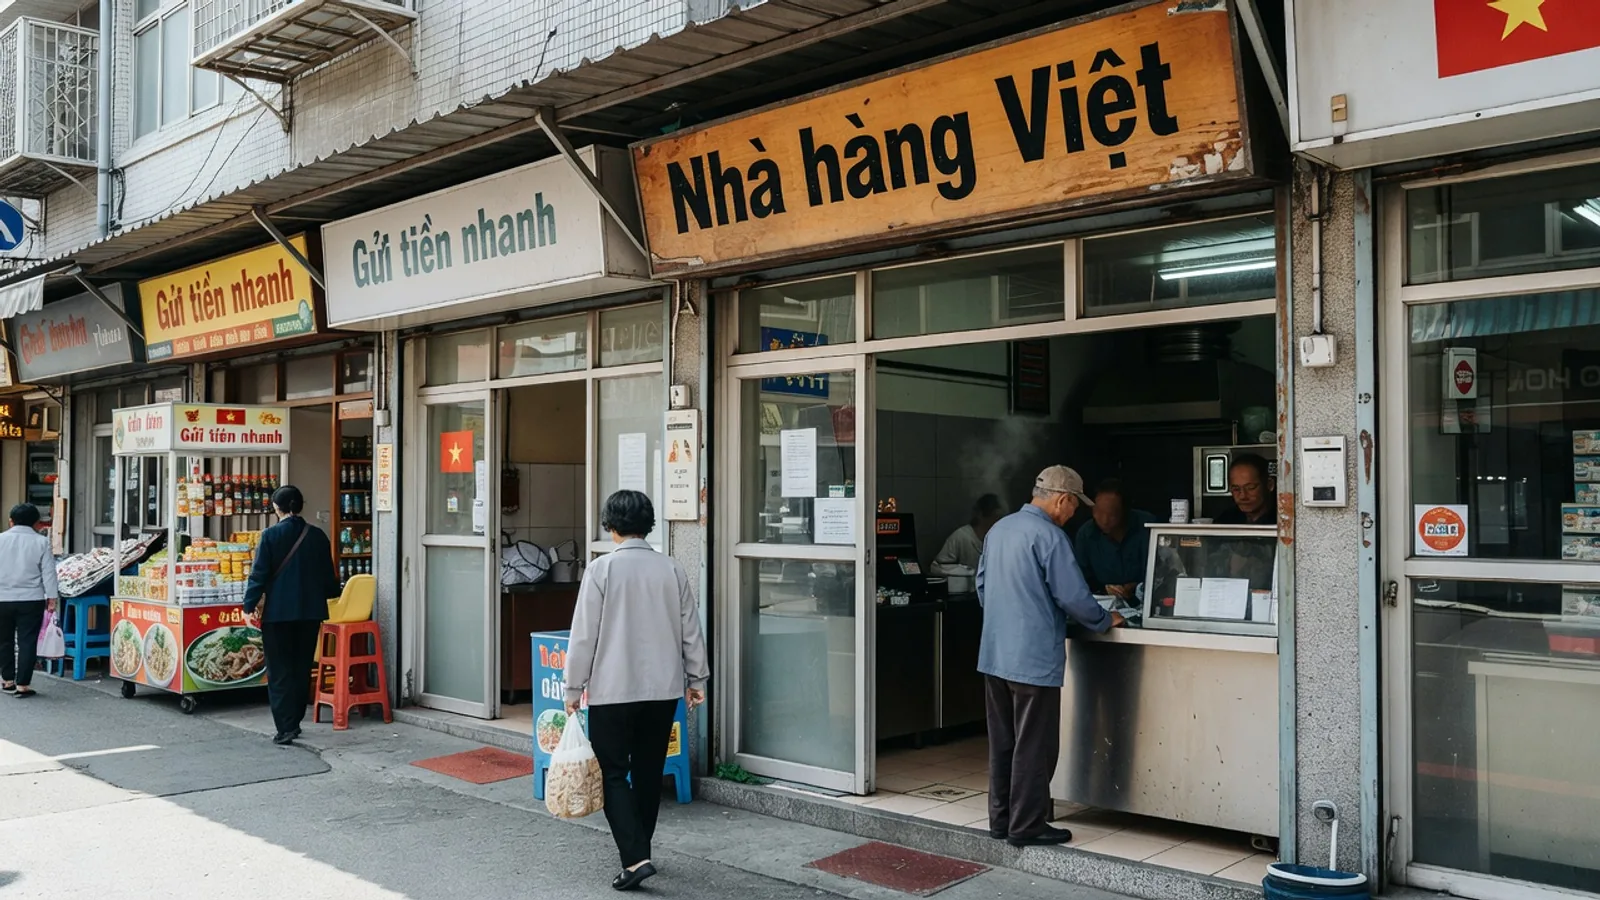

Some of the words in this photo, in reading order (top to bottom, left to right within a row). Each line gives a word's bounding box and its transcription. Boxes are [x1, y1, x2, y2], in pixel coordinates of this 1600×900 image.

[667, 138, 786, 234] Nhà
[799, 111, 977, 201] hàng
[994, 41, 1179, 169] Việt
[352, 230, 393, 288] Gửi
[400, 213, 453, 277] tiền
[461, 192, 557, 264] nhanh
[156, 284, 186, 331] Gửi
[230, 258, 295, 314] nhanh
[241, 429, 283, 443] nhanh
